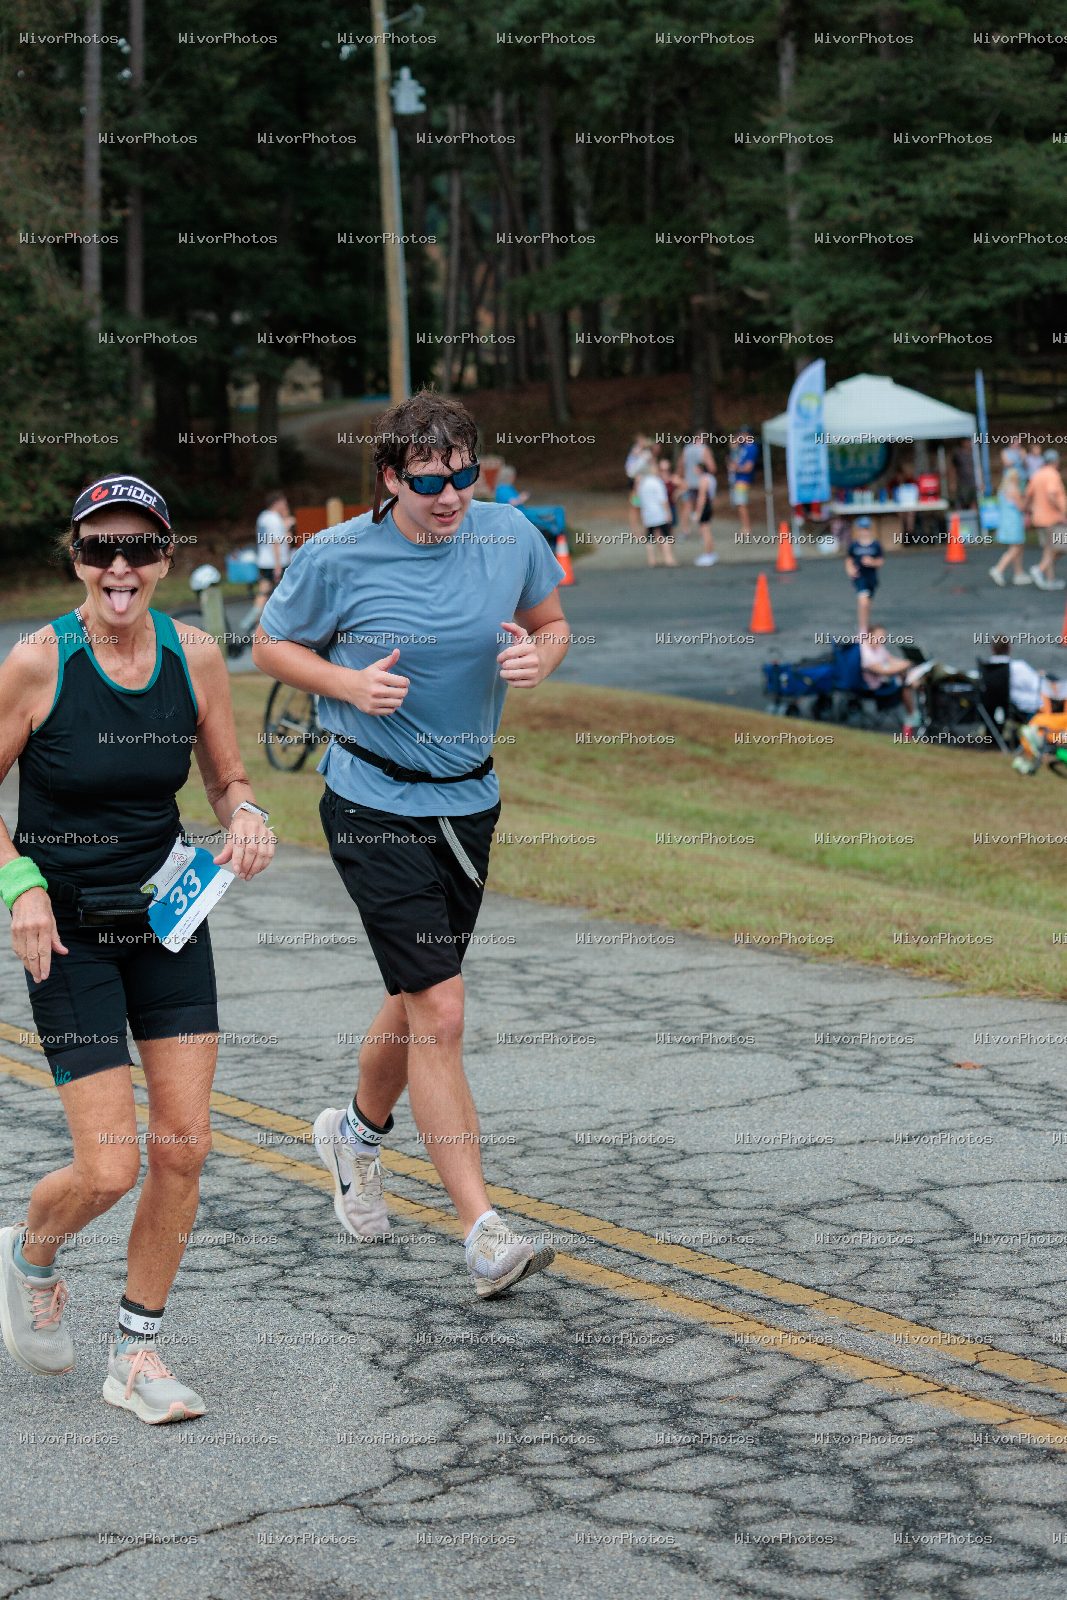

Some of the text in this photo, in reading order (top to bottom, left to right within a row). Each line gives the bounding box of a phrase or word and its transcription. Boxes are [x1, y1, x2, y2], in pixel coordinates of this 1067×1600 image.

[111, 484, 157, 507] TriDot
[170, 869, 201, 916] 33
[143, 1322, 156, 1331] 33
